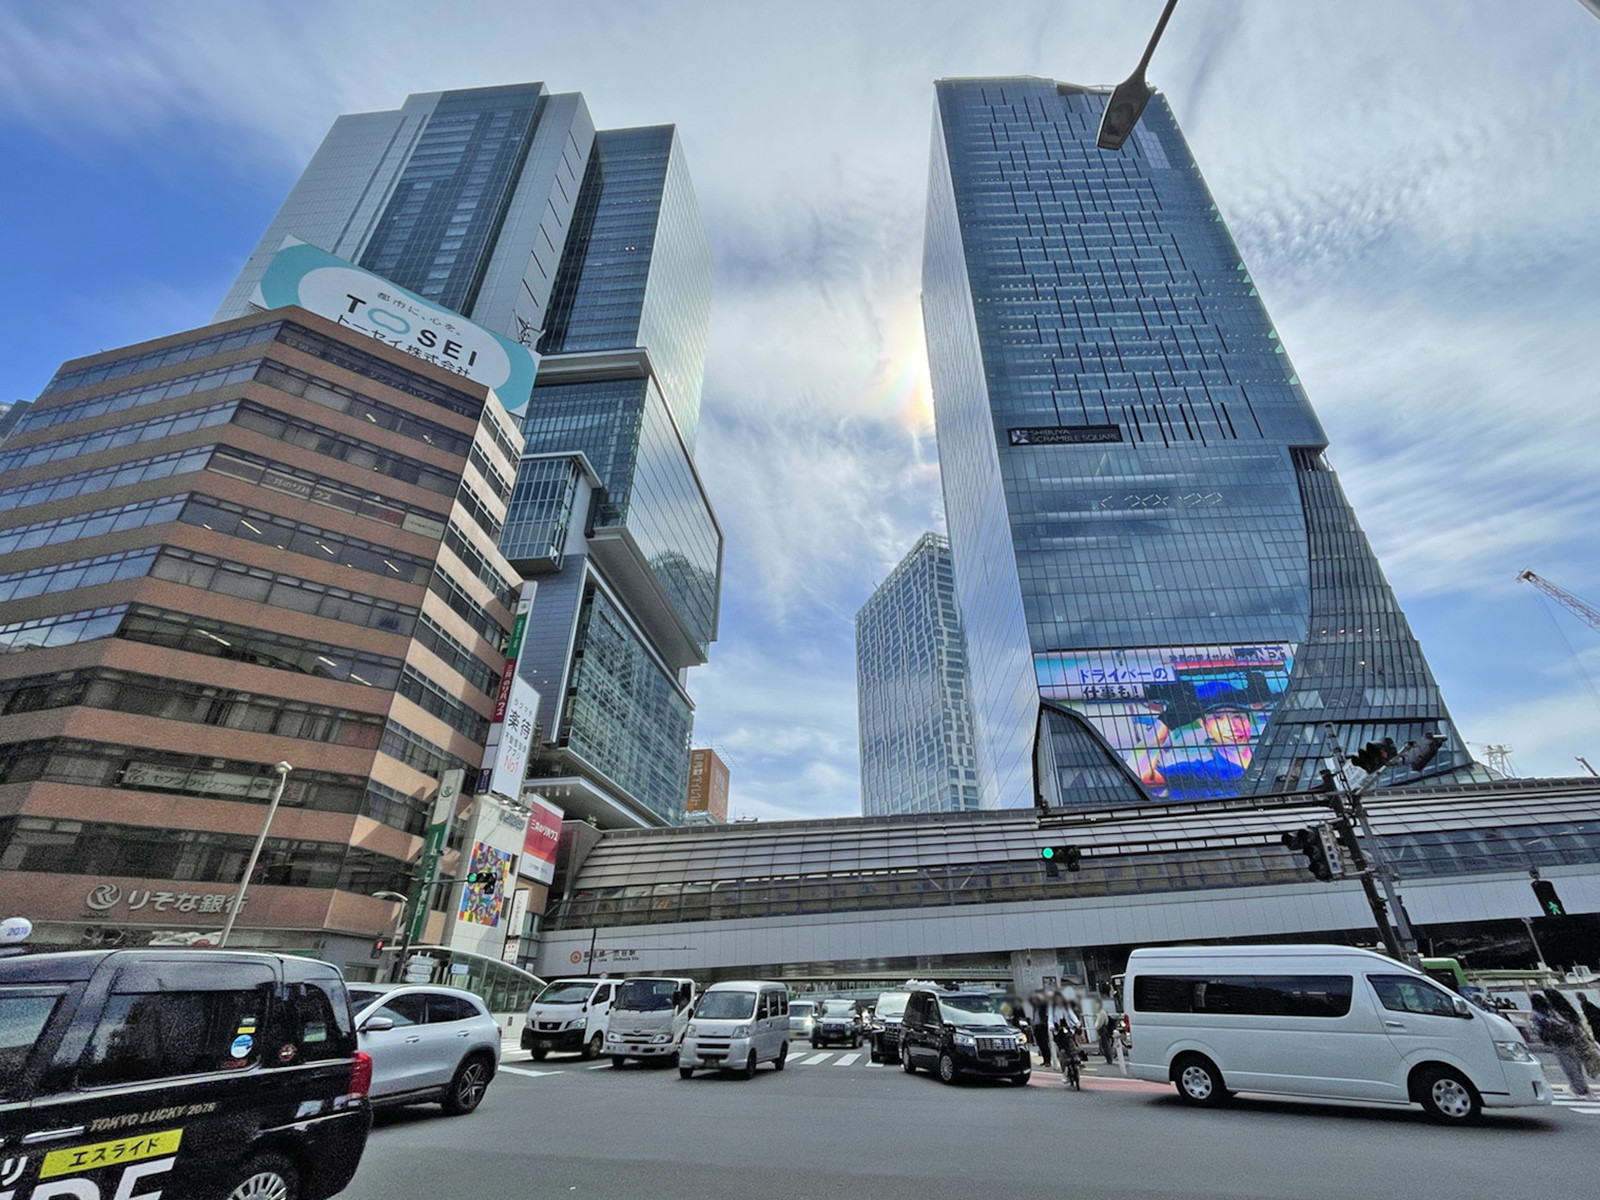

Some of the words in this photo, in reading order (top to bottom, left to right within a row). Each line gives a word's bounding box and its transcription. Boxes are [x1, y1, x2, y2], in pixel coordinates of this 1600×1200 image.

[1080, 667, 1168, 683] ドライバーの
[90, 1113, 139, 1132] TOKYO
[139, 1105, 186, 1122] LUCKY
[68, 1136, 160, 1168] エスライド
